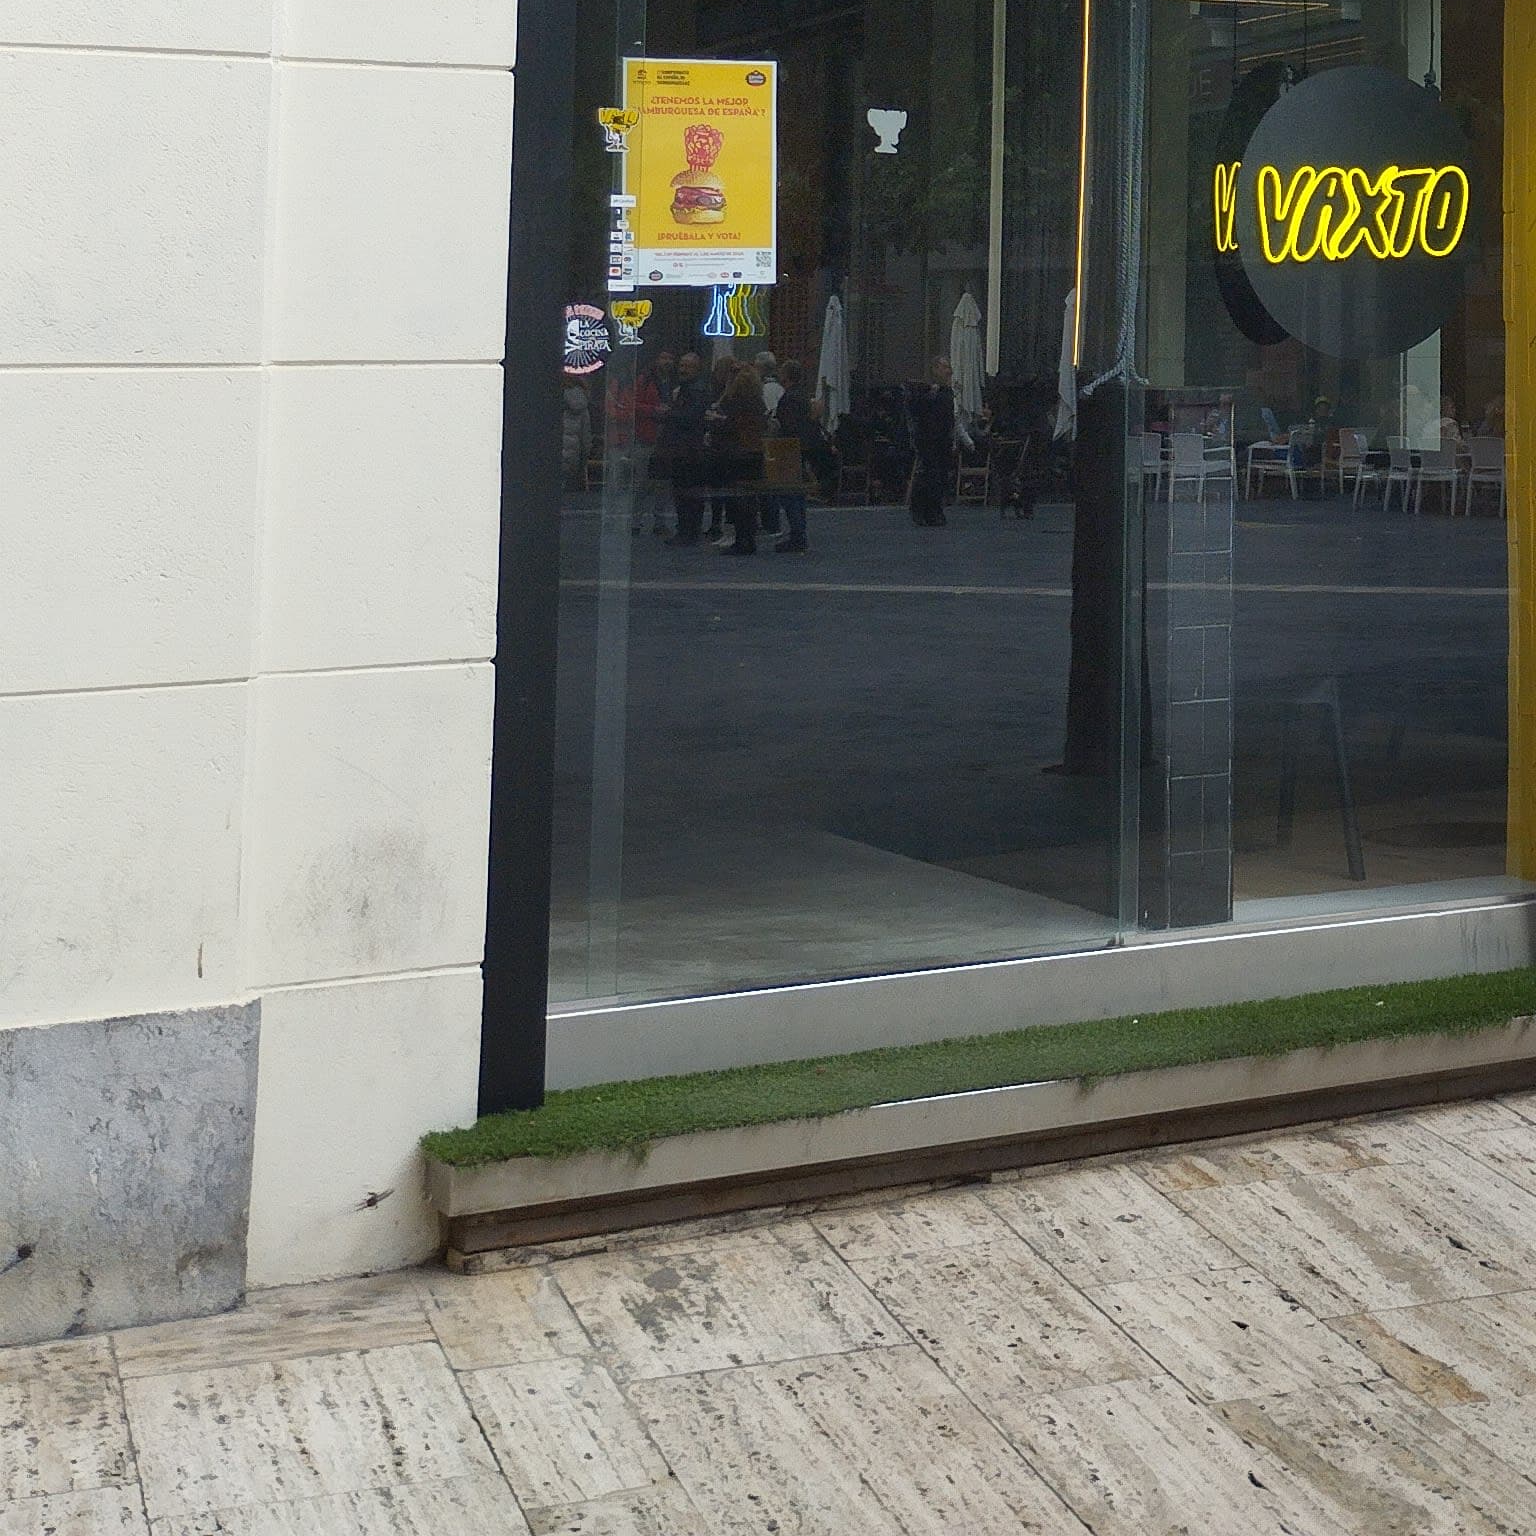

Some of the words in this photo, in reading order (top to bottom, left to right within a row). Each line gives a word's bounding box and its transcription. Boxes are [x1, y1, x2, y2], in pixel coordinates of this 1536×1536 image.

[702, 97, 714, 106] LA
[707, 107, 720, 116] DE
[1258, 165, 1470, 263] VAXTO
